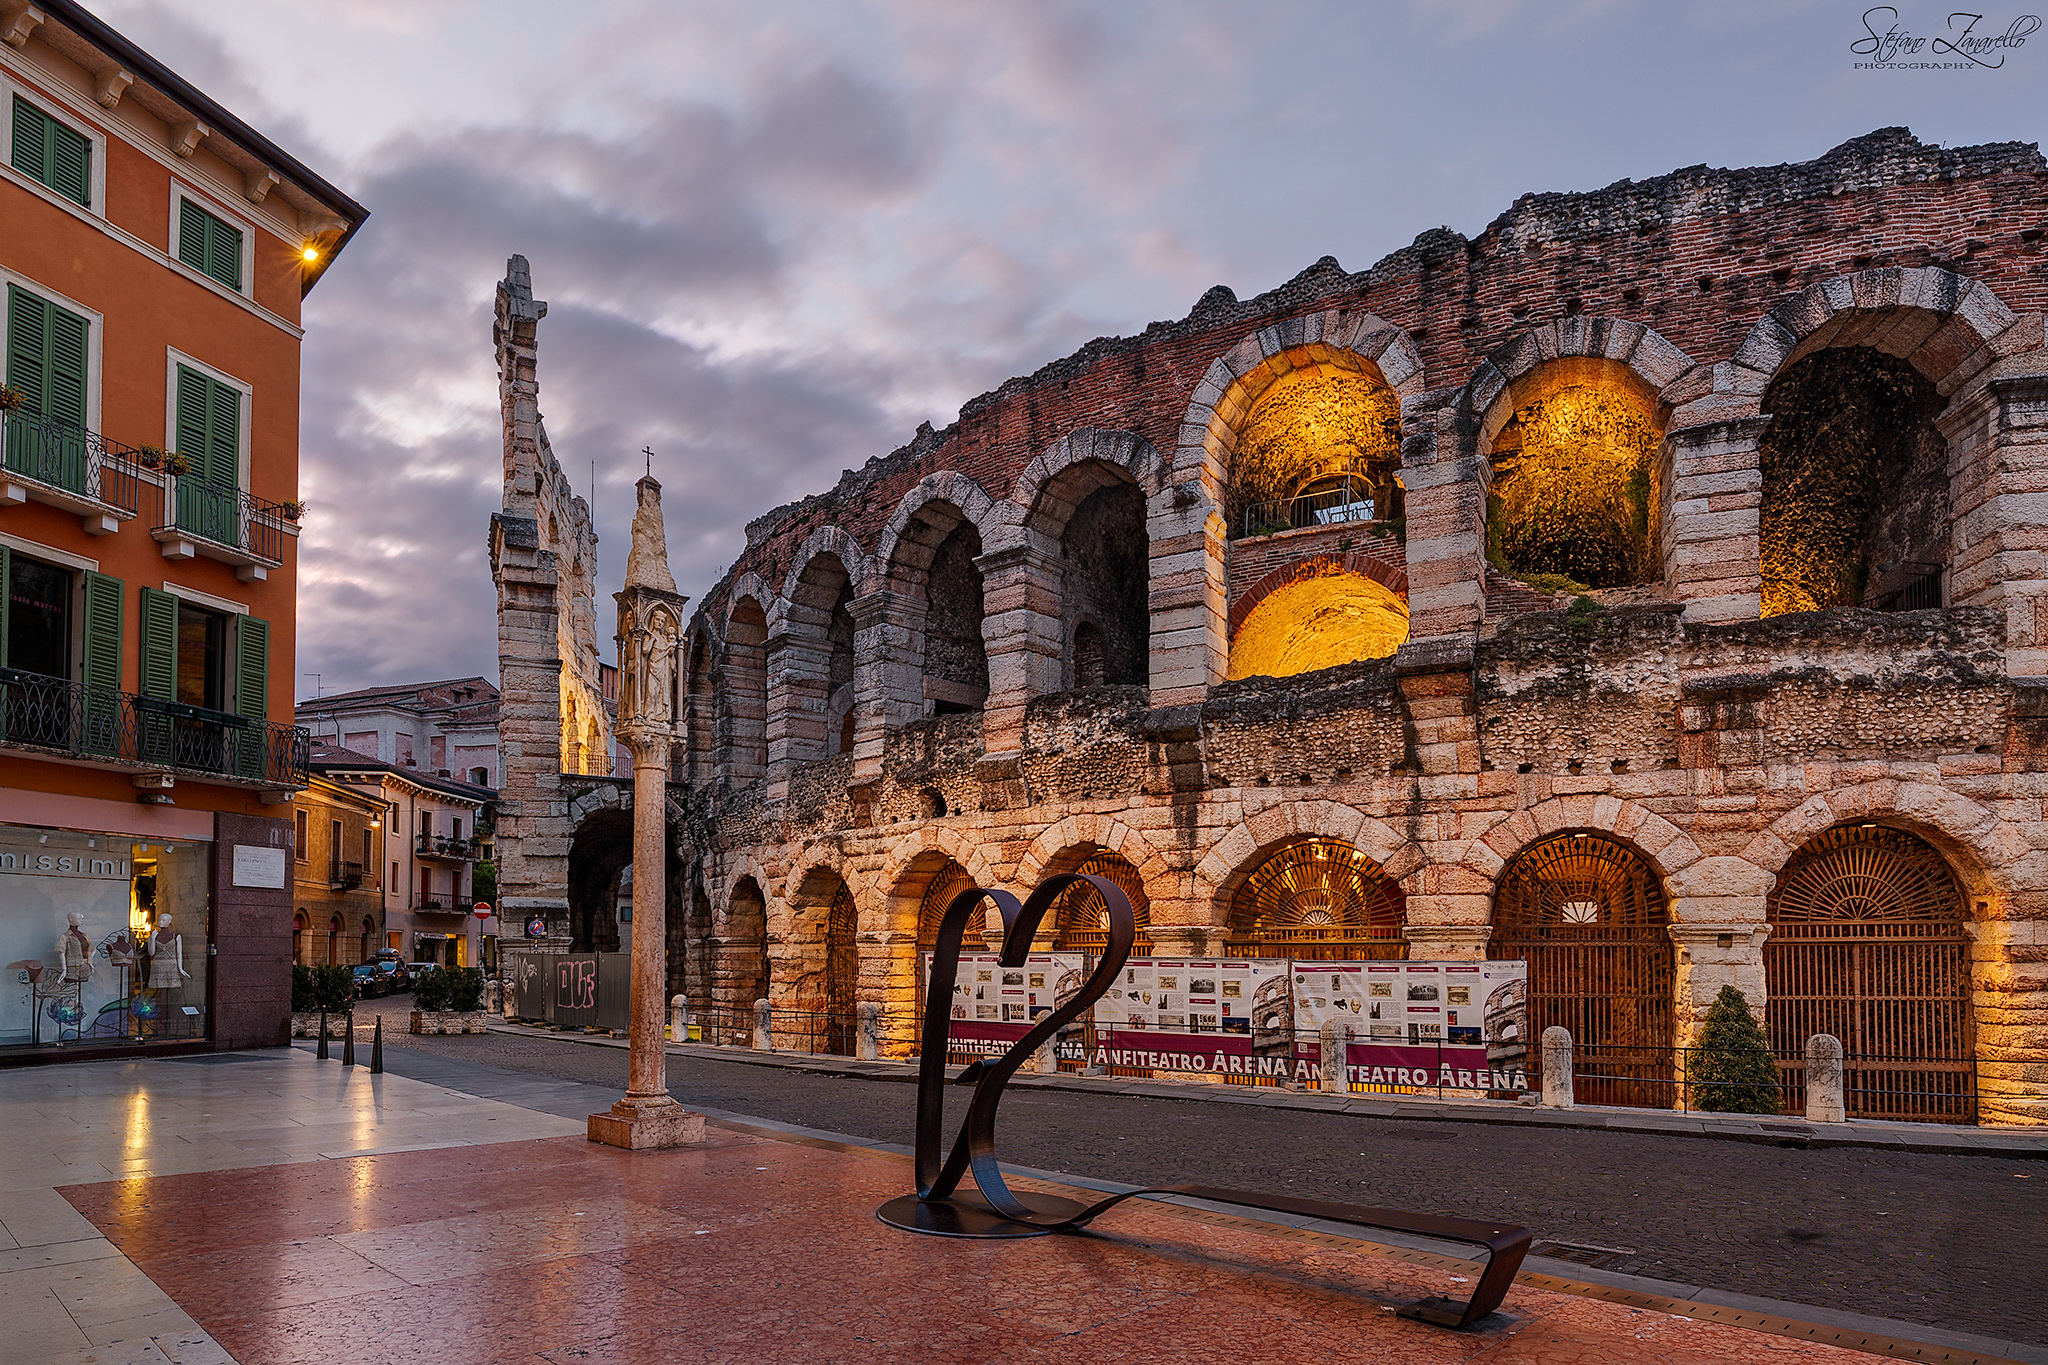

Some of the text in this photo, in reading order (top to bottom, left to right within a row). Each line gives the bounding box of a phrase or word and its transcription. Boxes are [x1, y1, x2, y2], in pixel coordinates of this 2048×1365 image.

[1095, 1045, 1287, 1076] ANFITEATRO ARENA
[1436, 1062, 1528, 1090] ARENA
